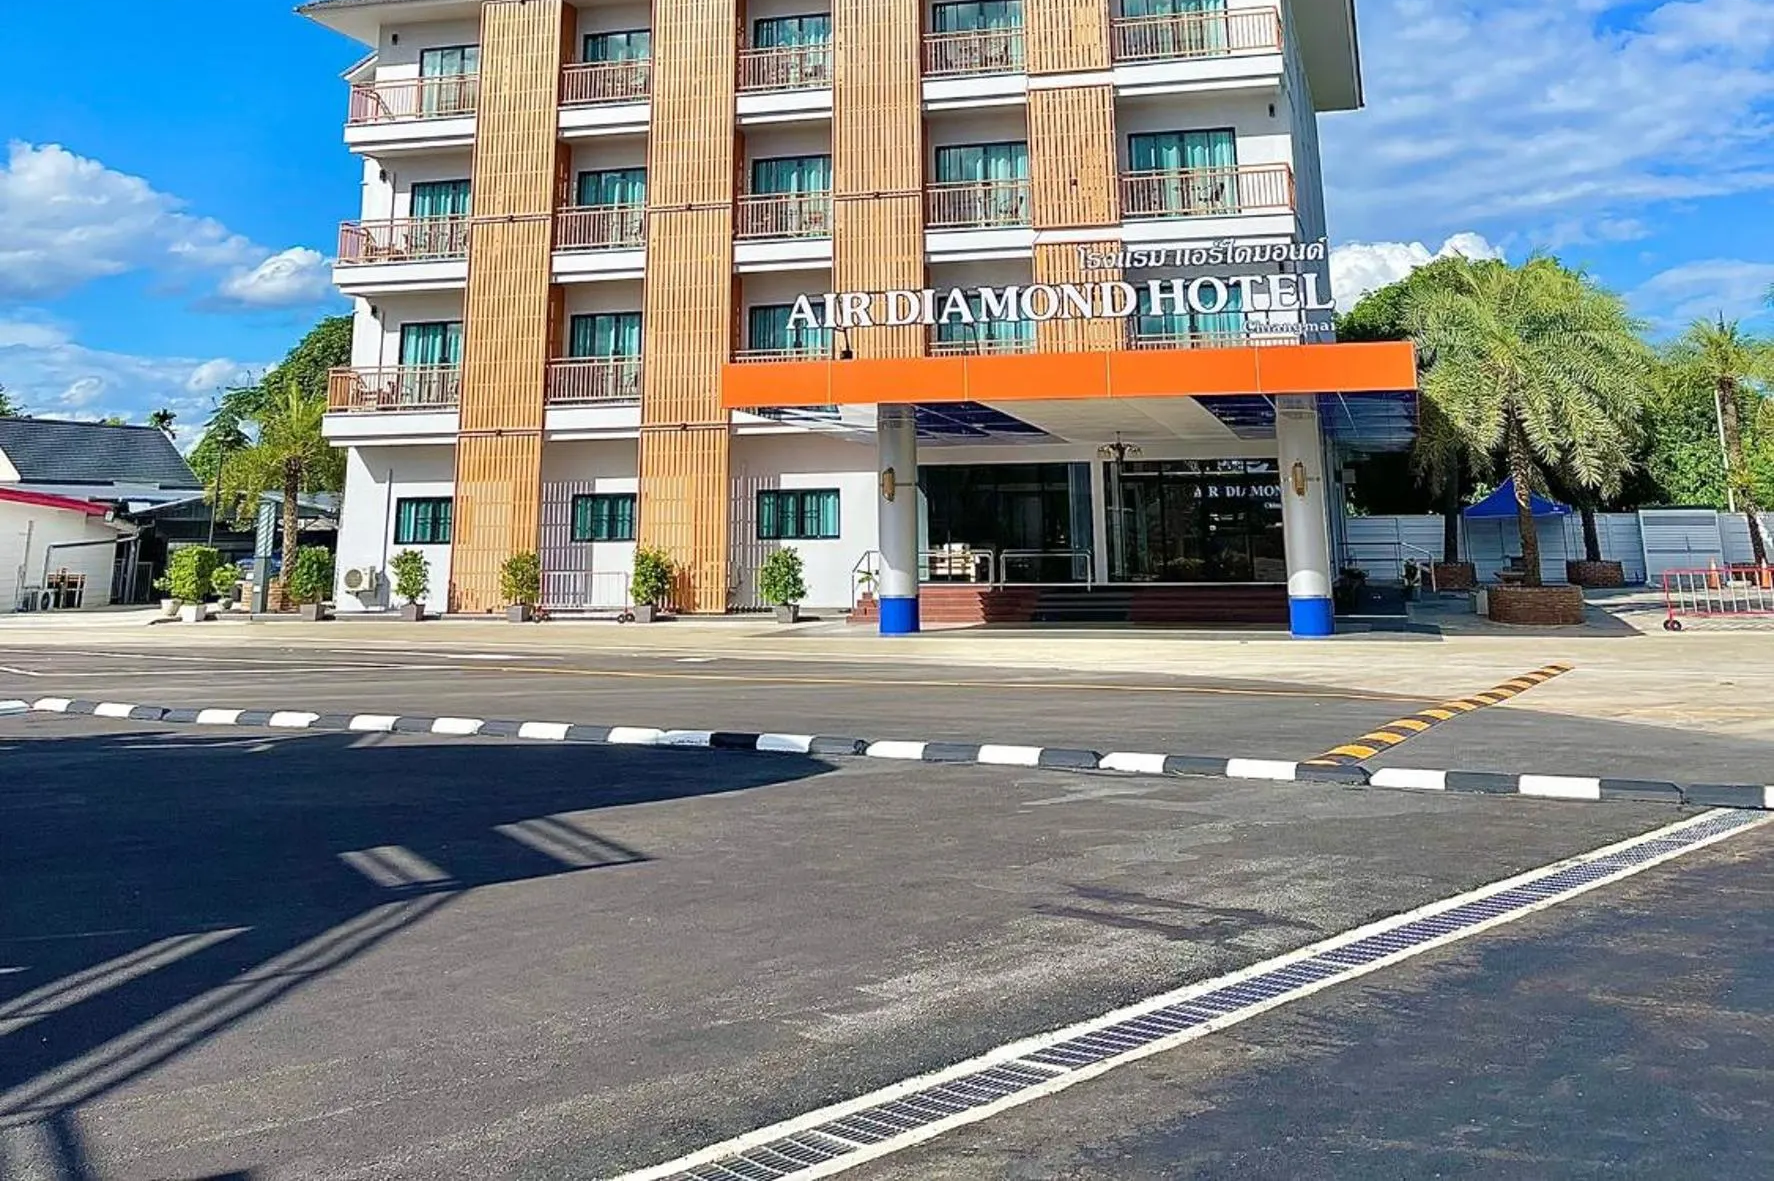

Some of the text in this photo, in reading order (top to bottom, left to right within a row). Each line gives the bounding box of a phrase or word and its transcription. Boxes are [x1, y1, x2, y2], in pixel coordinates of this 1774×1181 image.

[1077, 243, 1165, 269] โรงแรม
[786, 273, 1336, 330] AIR DIAMOND HOTEL
[1193, 485, 1219, 498] AR
